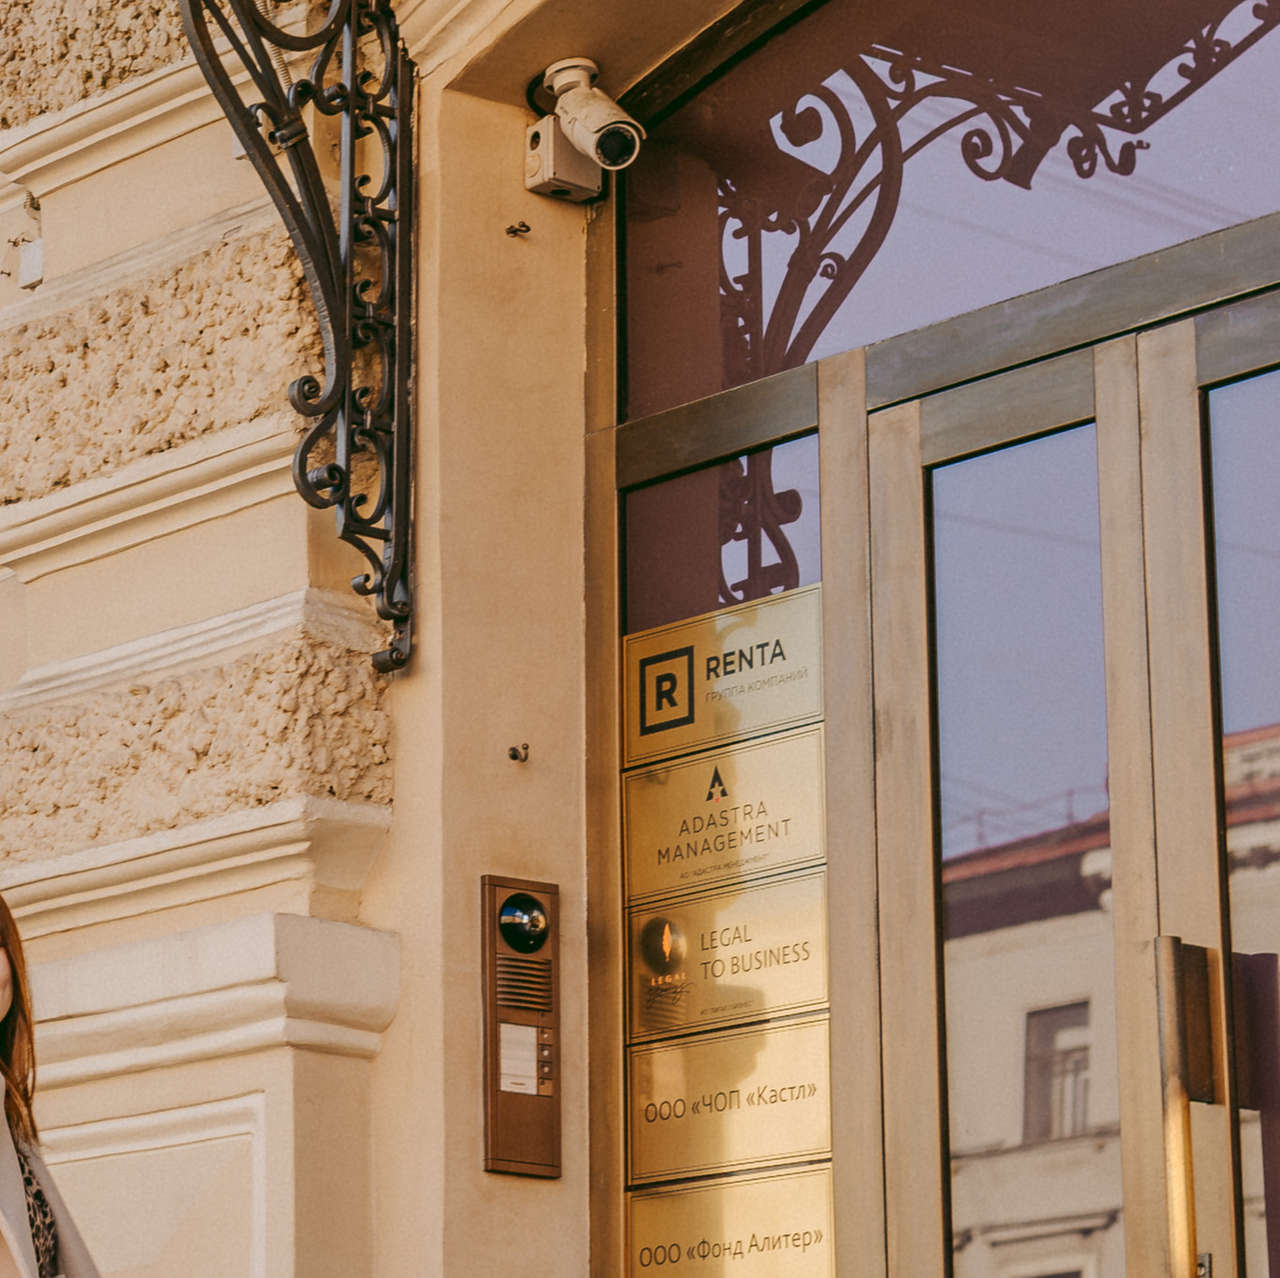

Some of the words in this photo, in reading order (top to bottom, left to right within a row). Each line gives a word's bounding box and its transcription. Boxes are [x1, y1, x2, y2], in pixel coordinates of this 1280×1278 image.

[705, 638, 787, 681] RENTA
[705, 684, 746, 704] ГРУППА
[678, 800, 769, 837] ADASTRA
[657, 818, 792, 865] MANAGEMENT
[700, 923, 753, 952] LEGAL
[650, 972, 687, 987] LEGAL
[700, 958, 726, 981] TO
[730, 941, 811, 975] BUSINESS
[644, 1097, 686, 1123] ООО
[691, 1089, 741, 1116] «ЧОП
[746, 1082, 818, 1108] «Кастл»
[639, 1242, 682, 1268] ООО
[686, 1238, 744, 1262] «Фонд
[747, 1228, 824, 1256] Алитер»
